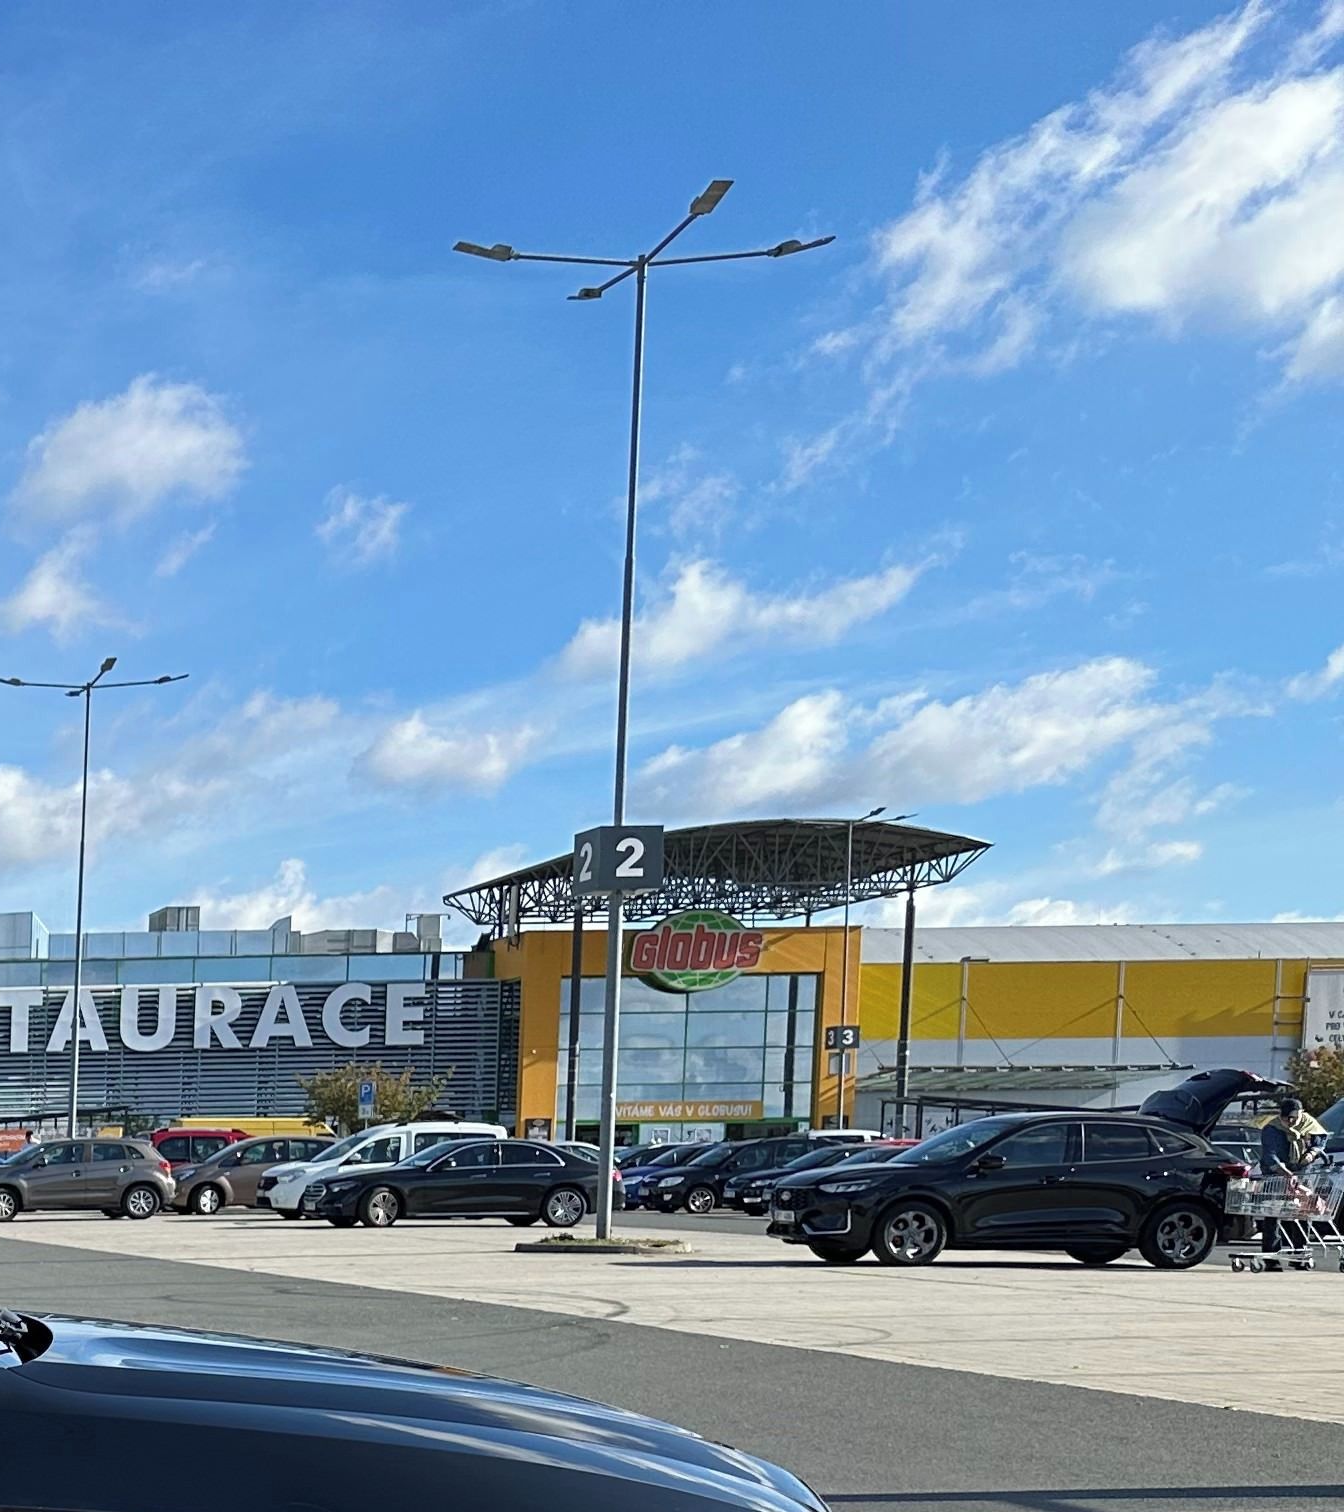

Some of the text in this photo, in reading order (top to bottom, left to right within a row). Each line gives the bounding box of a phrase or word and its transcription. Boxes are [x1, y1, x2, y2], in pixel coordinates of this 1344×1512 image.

[579, 842, 593, 882] 2
[615, 837, 644, 877] 2
[632, 924, 763, 970] Globus
[827, 1030, 835, 1046] 3
[842, 1029, 854, 1045] 3
[362, 1084, 371, 1098] P
[686, 1104, 695, 1117] V
